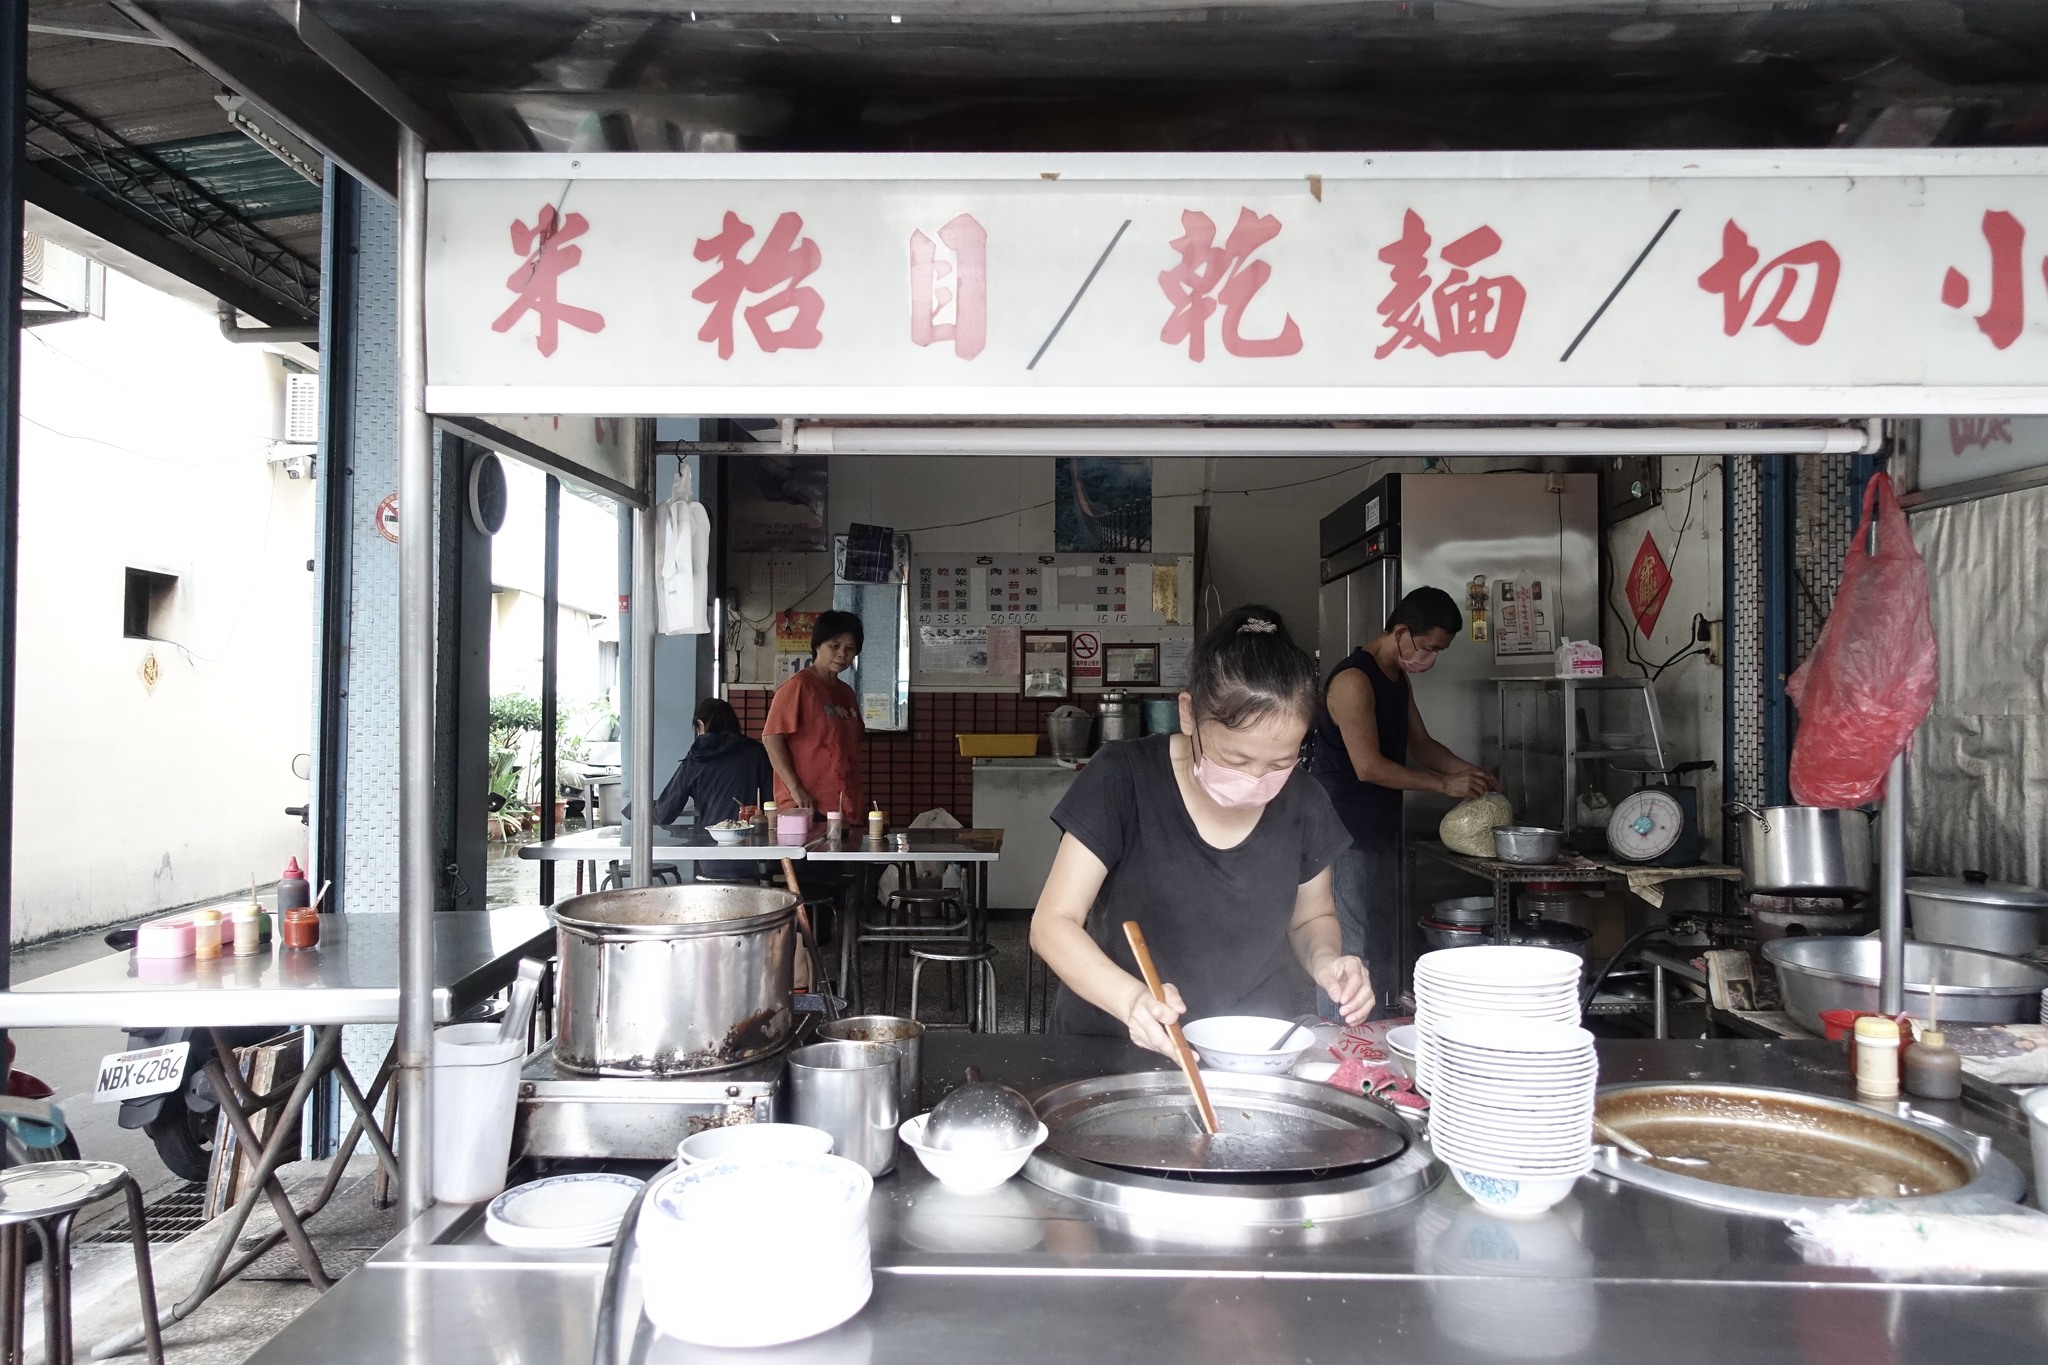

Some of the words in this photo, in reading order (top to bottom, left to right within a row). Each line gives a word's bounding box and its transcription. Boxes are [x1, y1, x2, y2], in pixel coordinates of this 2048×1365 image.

[976, 555, 1117, 566] 古早味
[955, 568, 967, 612] 乾米粉(湯
[1096, 567, 1108, 612] 油豆腐
[919, 614, 932, 624] 40
[937, 614, 950, 624] 35
[955, 614, 967, 625] 35
[990, 613, 1004, 625] 50
[1008, 613, 1021, 624] 50
[1024, 613, 1037, 624] 50
[1097, 614, 1108, 624] 15
[1115, 614, 1128, 623] 15
[97, 1055, 183, 1092] NBX-6286
